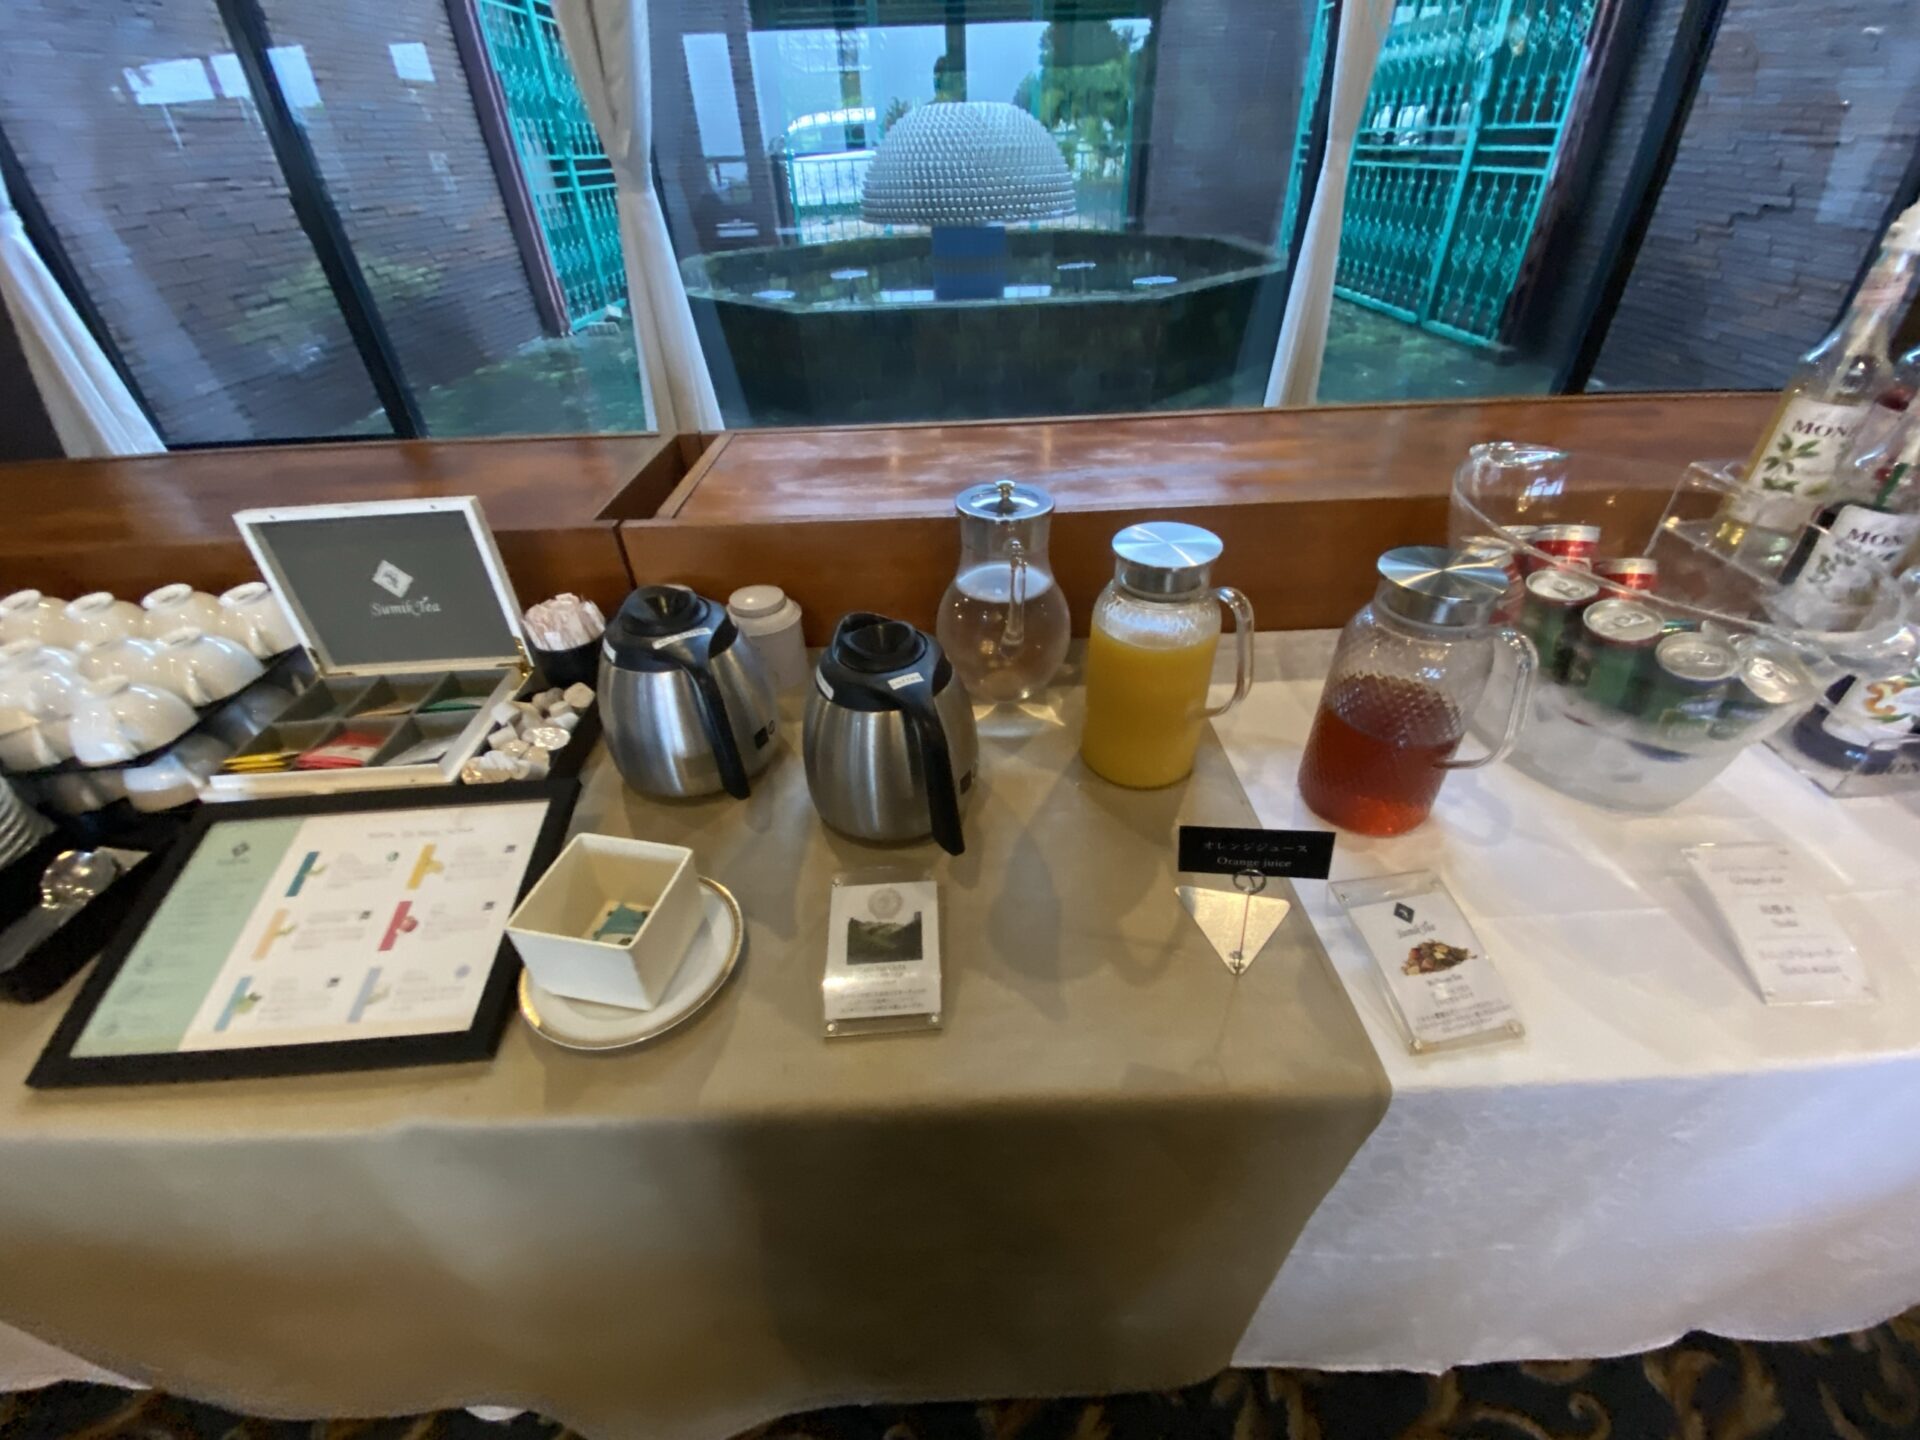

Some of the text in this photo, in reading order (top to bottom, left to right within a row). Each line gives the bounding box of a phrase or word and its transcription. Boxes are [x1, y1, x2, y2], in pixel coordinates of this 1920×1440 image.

[1792, 418, 1850, 437] MON
[1848, 528, 1902, 546] MON
[1216, 856, 1293, 869] Orange juice
